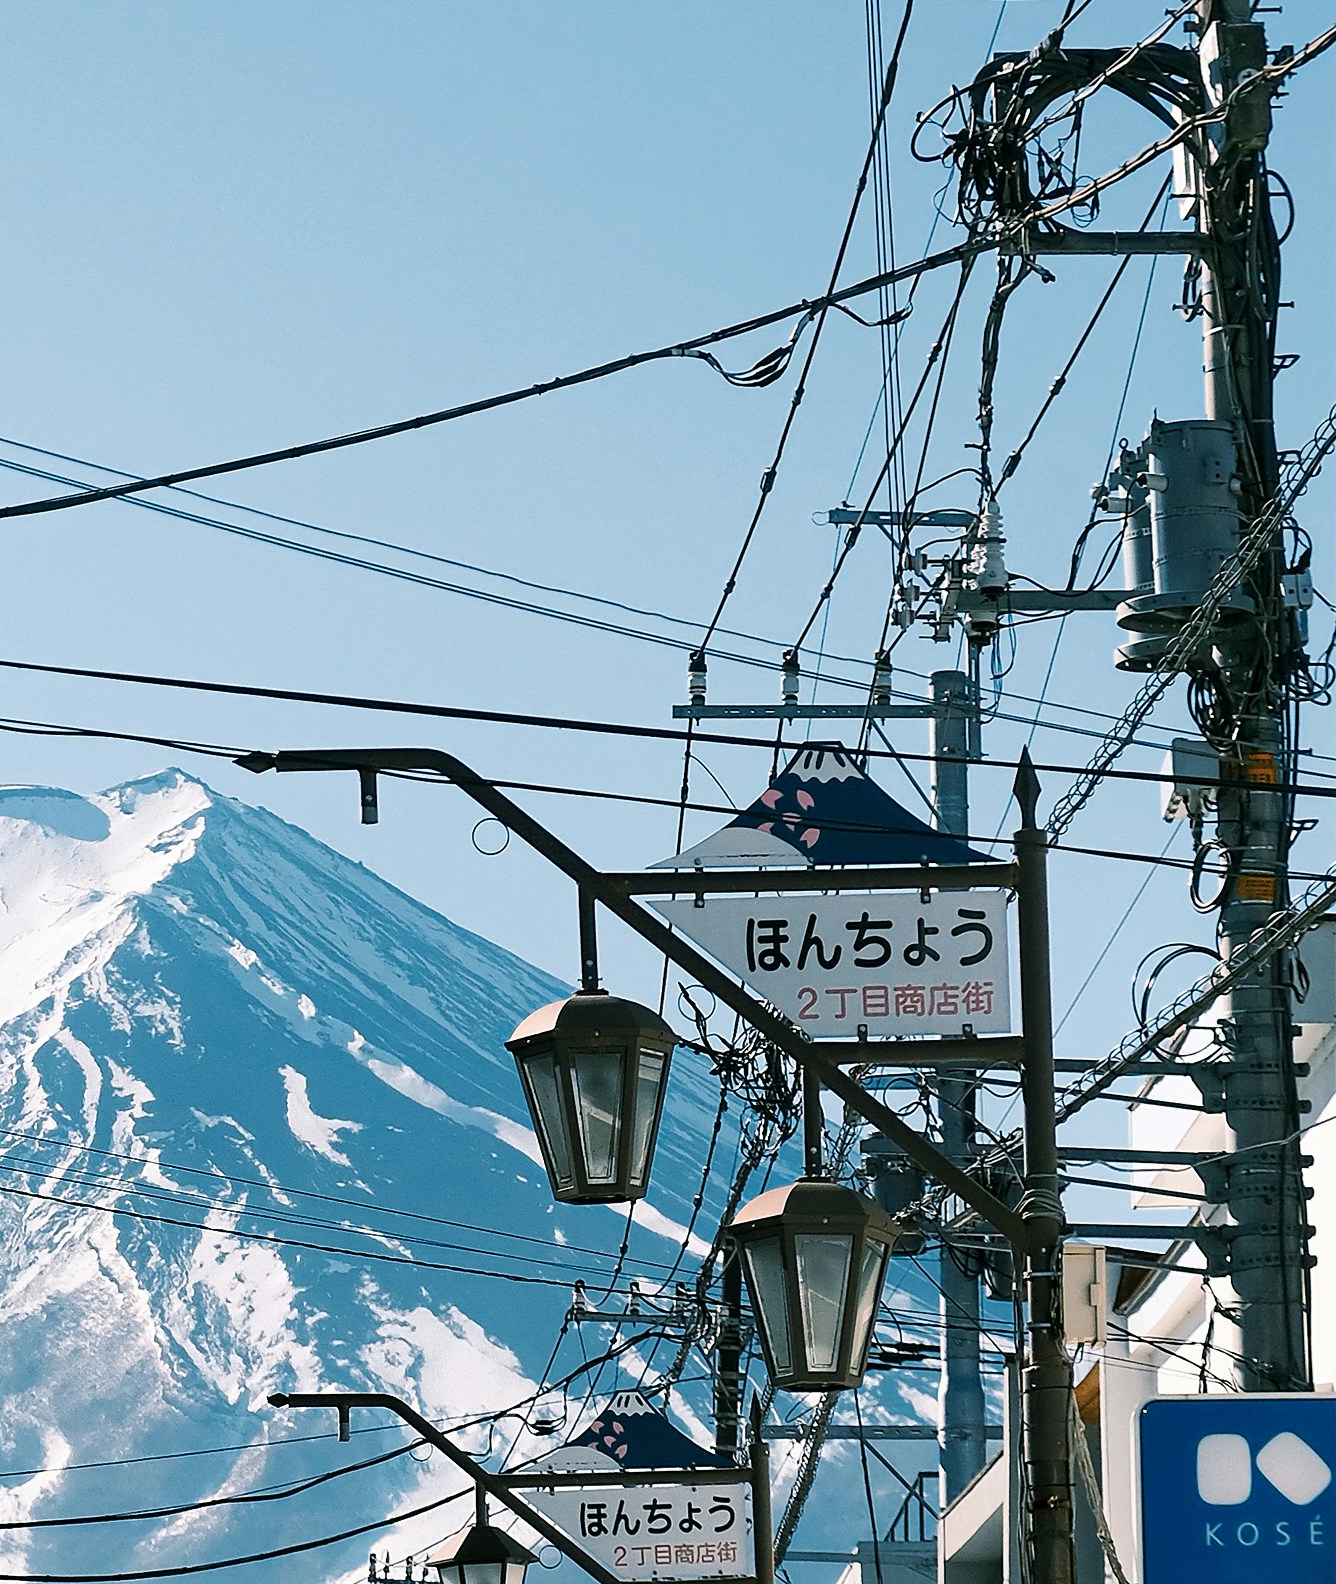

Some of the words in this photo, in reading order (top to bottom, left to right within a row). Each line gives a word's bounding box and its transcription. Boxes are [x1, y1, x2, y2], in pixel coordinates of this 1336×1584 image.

[745, 908, 995, 972] ほんちょう
[797, 980, 995, 1020] 2丁目商店街
[579, 1495, 737, 1537] ほんちょう
[1205, 1514, 1325, 1548] KOSÉ
[613, 1541, 738, 1567] 2丁目商店街
